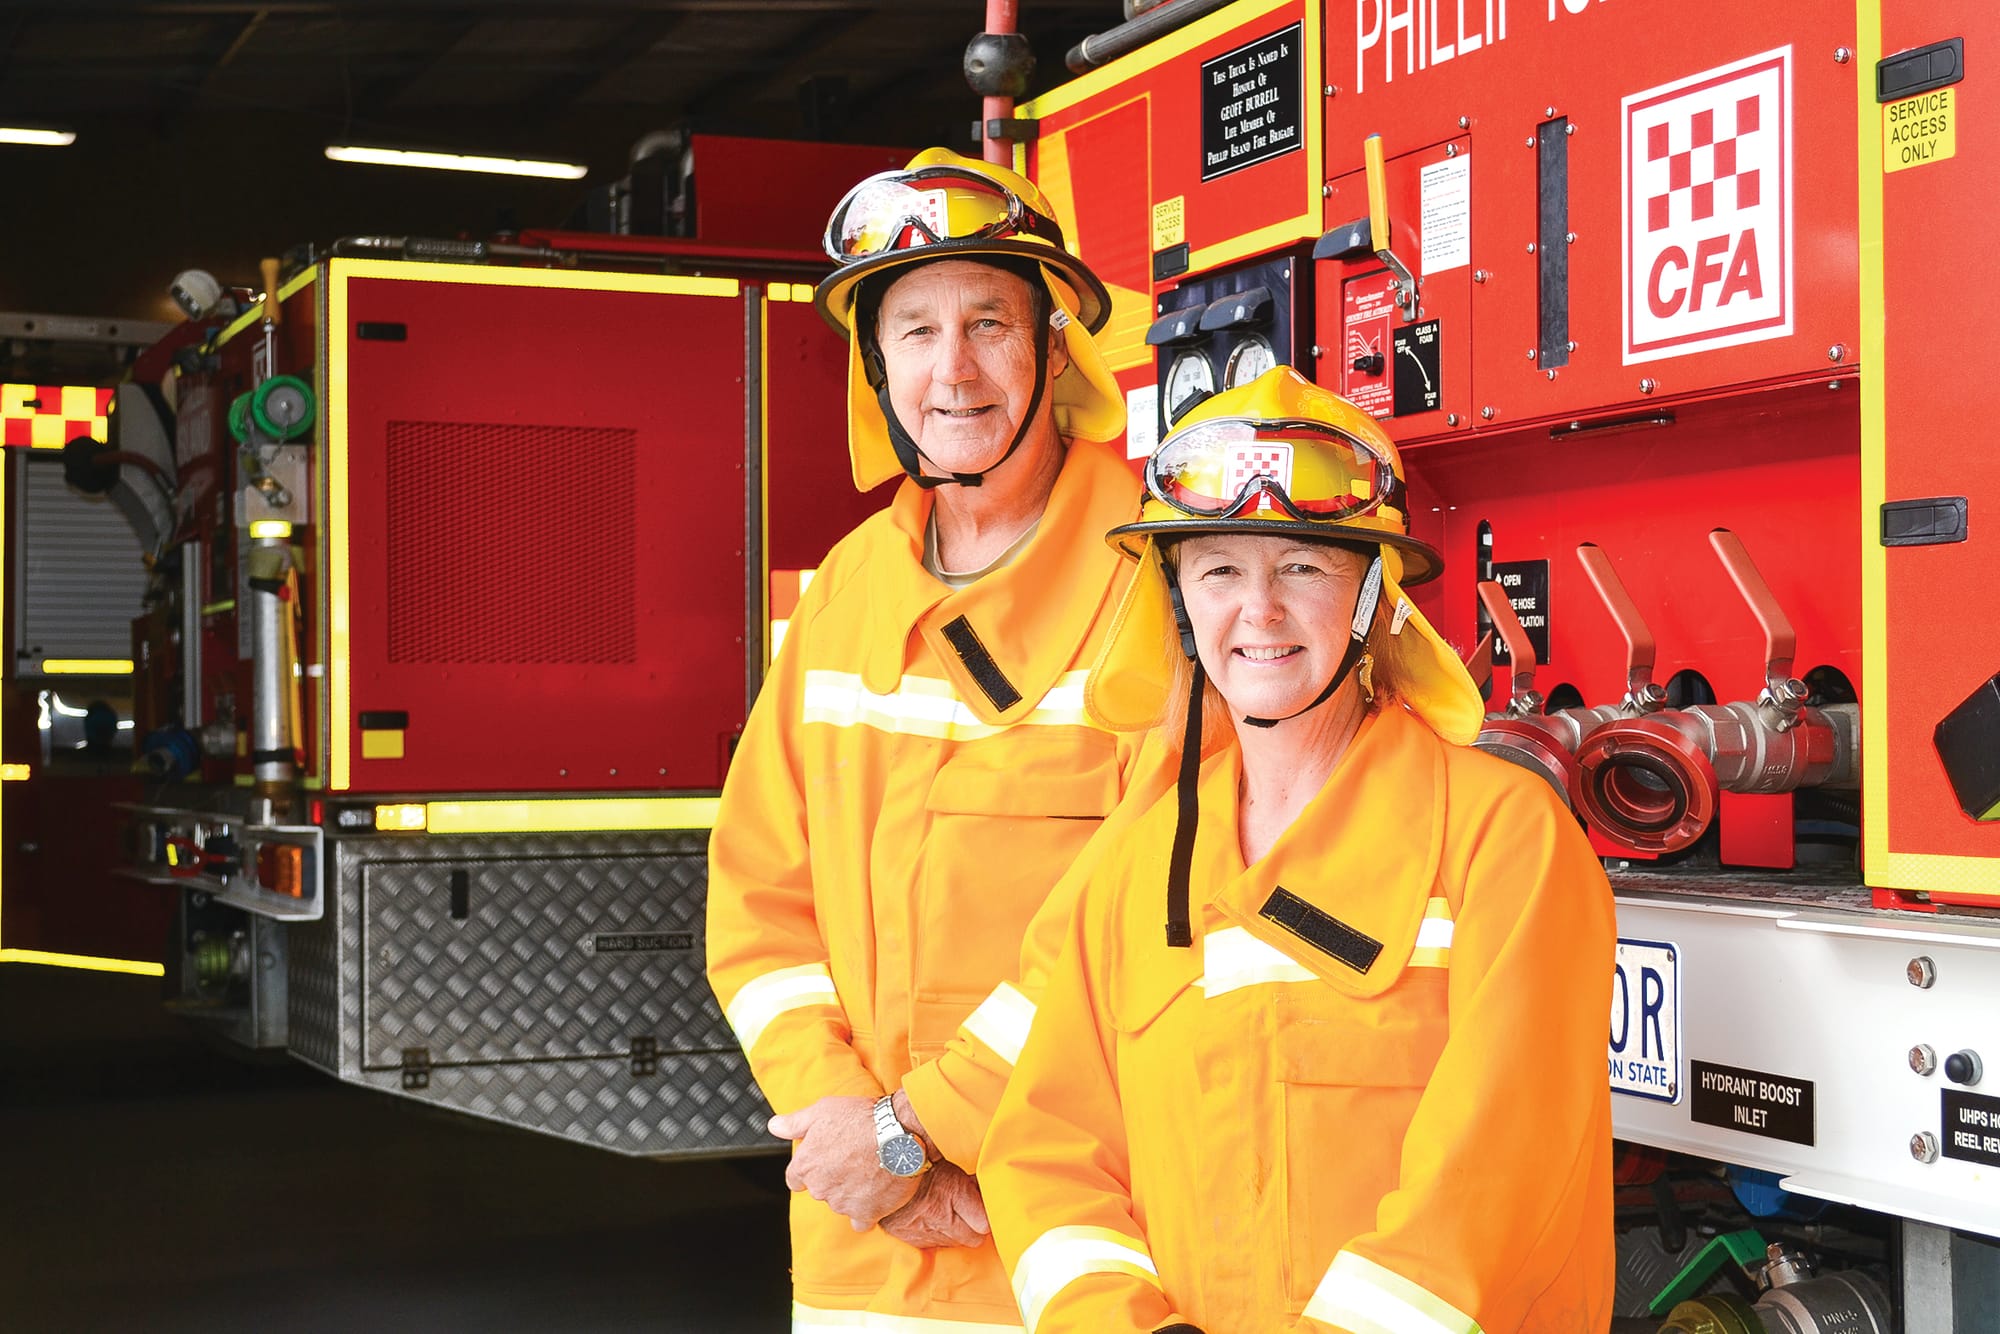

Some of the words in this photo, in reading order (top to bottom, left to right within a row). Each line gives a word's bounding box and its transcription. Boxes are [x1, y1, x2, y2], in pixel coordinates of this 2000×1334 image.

[1220, 101, 1243, 121] GEOFF
[1245, 87, 1280, 113] BURRELL
[1890, 91, 1948, 122] SERVICE
[1891, 114, 1947, 145] ACCESS
[1901, 139, 1937, 164] ONLY
[1156, 199, 1181, 218] SERVICE
[1157, 214, 1181, 232] ACCESS
[1648, 228, 1764, 319] CFA
[1415, 325, 1432, 337] CLASS
[1432, 323, 1438, 333] A
[1419, 333, 1434, 345] FOAM
[1503, 574, 1521, 587] OPEN
[1519, 597, 1536, 610] HOSE
[1518, 615, 1545, 628] OLATION
[1628, 1062, 1667, 1088] STATE
[1702, 1071, 1757, 1098] HYDRANT
[1759, 1082, 1802, 1107] BOOST
[1734, 1105, 1768, 1129] INLET
[1960, 1107, 1988, 1127] UHPS
[1954, 1130, 1982, 1150] REEL
